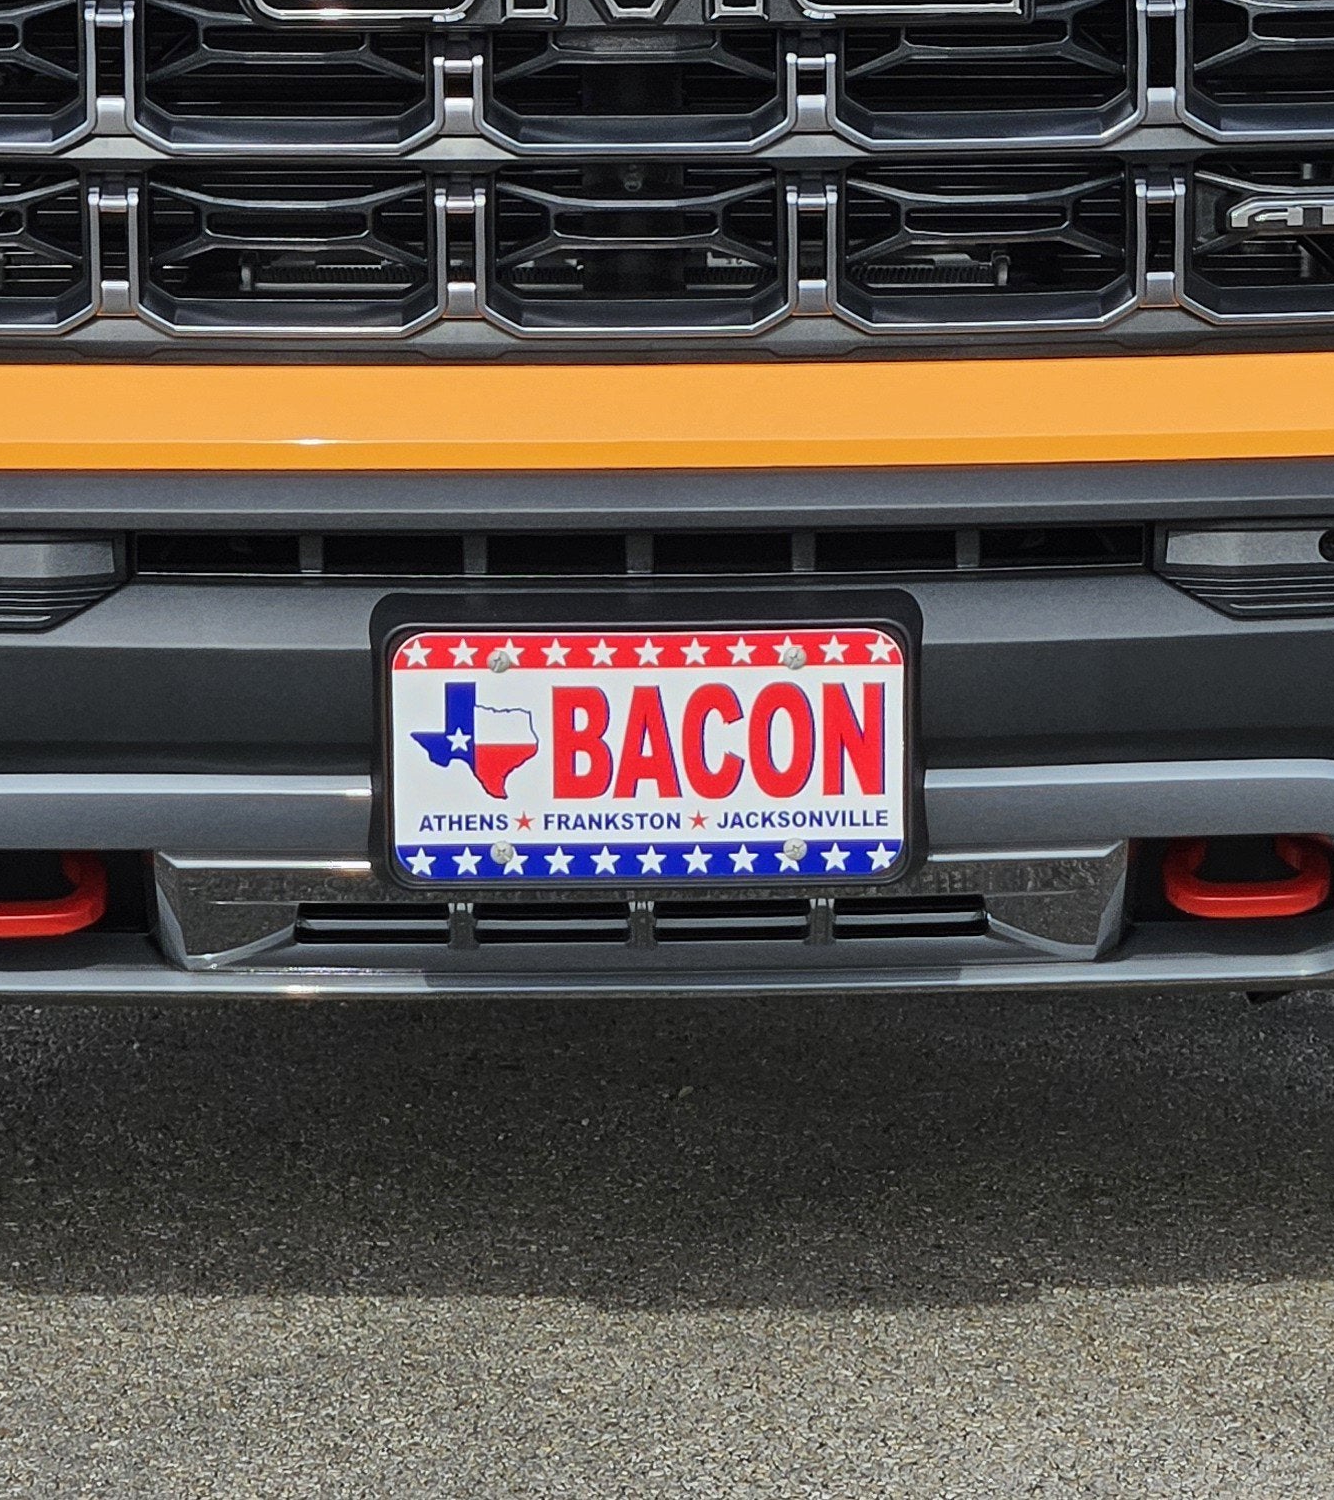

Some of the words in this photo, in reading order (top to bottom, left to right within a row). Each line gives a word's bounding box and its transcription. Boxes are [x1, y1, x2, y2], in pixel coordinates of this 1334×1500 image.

[551, 681, 885, 800] BACON
[418, 812, 510, 833] ATHENS
[543, 811, 682, 832] FRANKSTON
[716, 808, 890, 831] JACKSONVILLE
